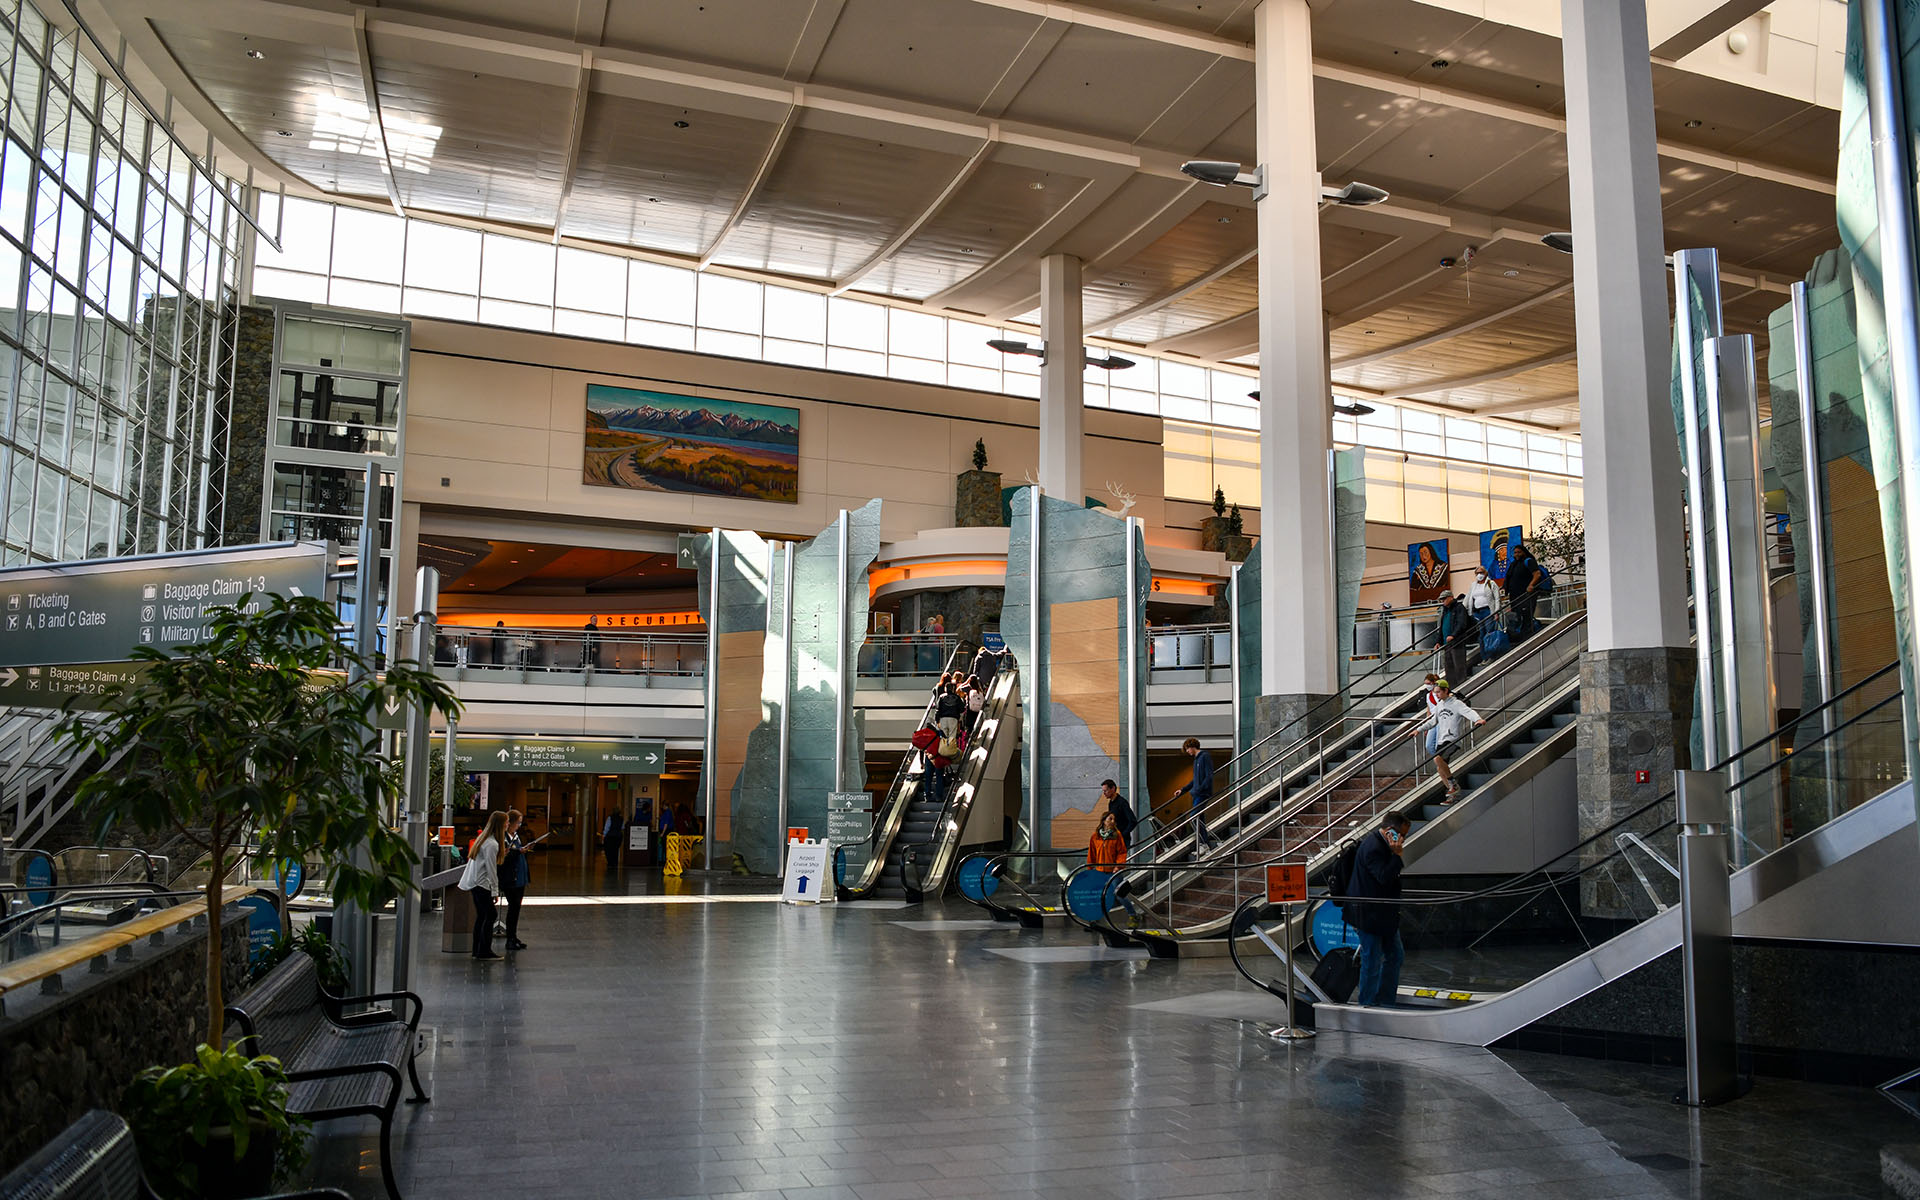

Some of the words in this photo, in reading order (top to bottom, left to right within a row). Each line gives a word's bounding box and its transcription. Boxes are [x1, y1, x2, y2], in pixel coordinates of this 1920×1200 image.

[164, 583, 209, 601] Baggage
[212, 578, 242, 595] Claim
[247, 575, 265, 593] 1-3
[28, 593, 69, 610] Ticketing
[162, 604, 196, 620] Visitor
[25, 614, 36, 631] A,
[38, 613, 46, 628] B
[48, 612, 66, 628] and
[68, 611, 76, 627] C
[78, 610, 106, 626] Gates
[160, 625, 200, 644] Military
[49, 667, 90, 682] Baggage
[92, 670, 118, 683] Claim
[48, 680, 60, 692] L1
[63, 683, 80, 694] and
[523, 744, 546, 753] Baggage
[547, 745, 565, 753] Claims
[831, 793, 845, 801] Ticket
[846, 793, 869, 801] Counters
